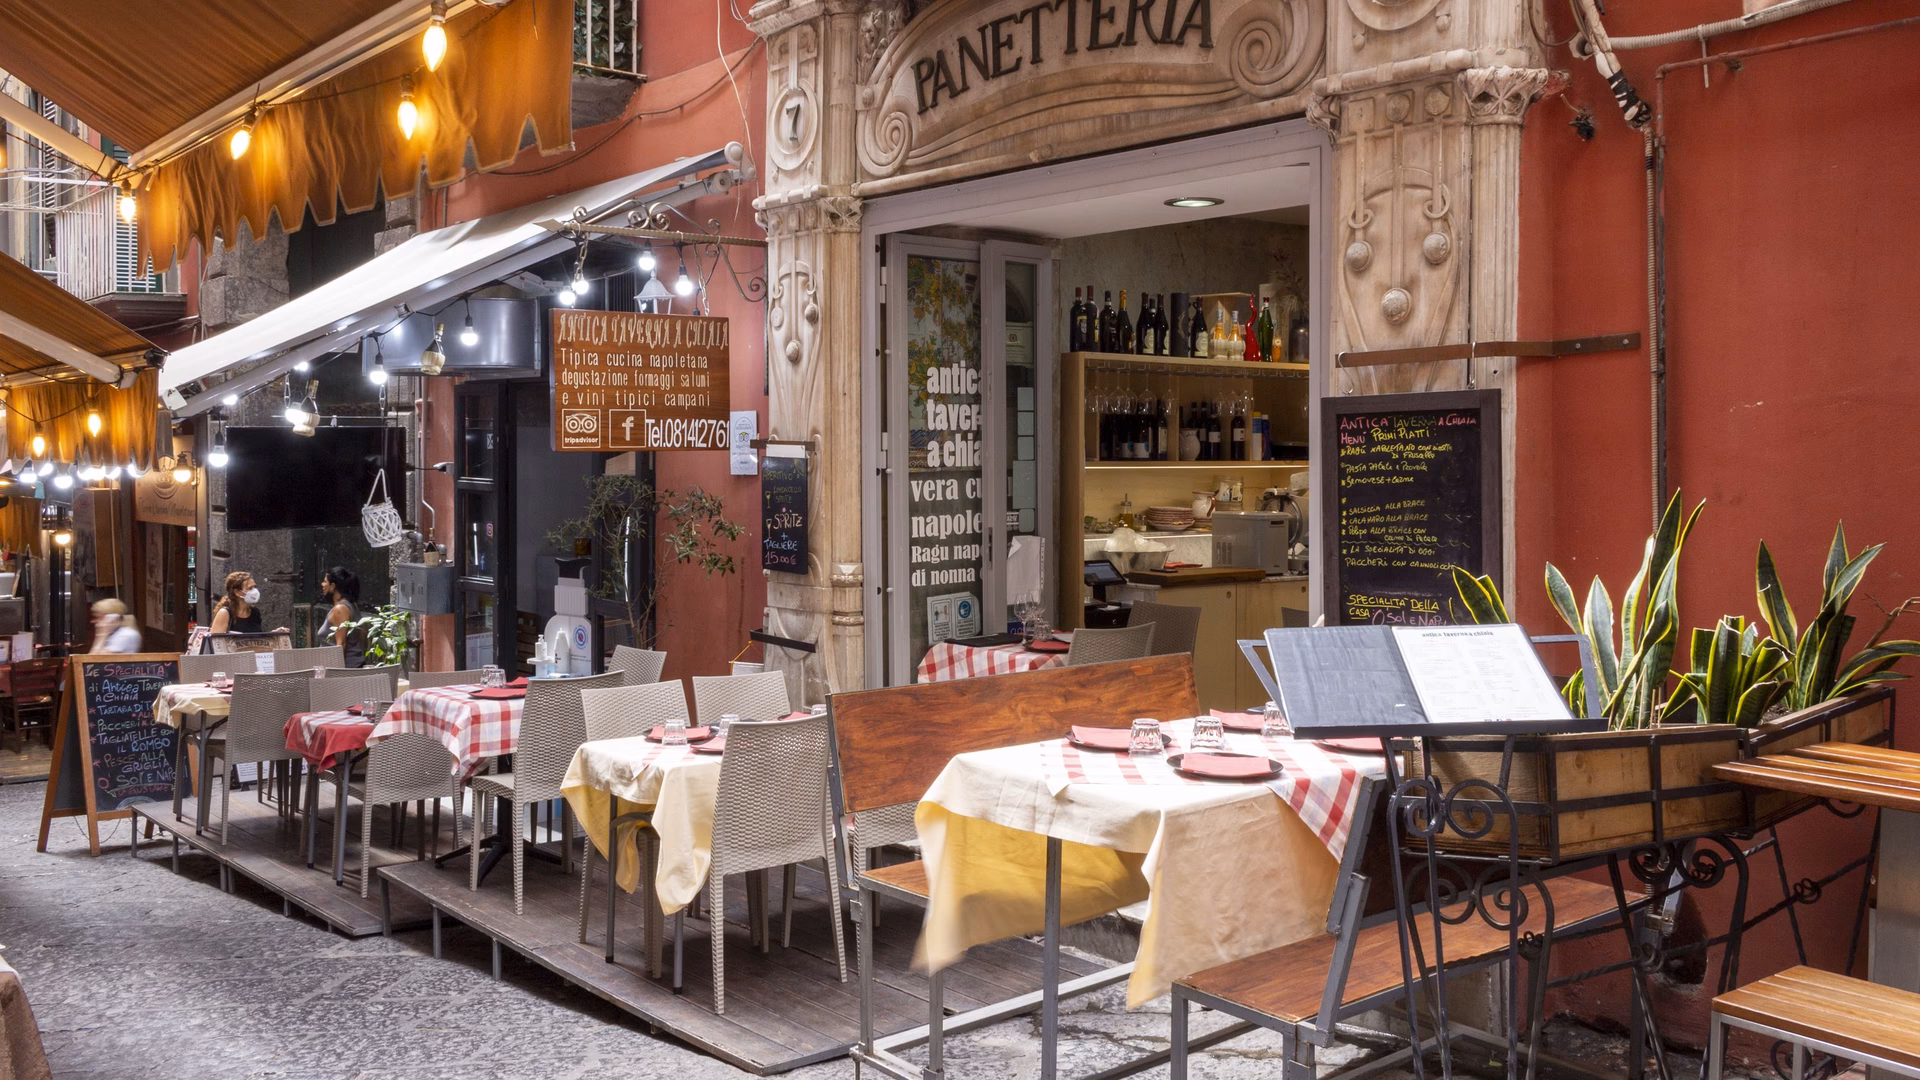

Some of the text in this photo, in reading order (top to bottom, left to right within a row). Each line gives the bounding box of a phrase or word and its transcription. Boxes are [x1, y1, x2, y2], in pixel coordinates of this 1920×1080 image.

[910, 0, 1214, 115] PANETTERIA
[786, 104, 801, 141] 7
[557, 313, 608, 346] ANTICA
[611, 314, 671, 349] TAVERNA
[673, 319, 682, 348] A
[561, 348, 708, 370] Tipica cucina napoletana
[561, 369, 710, 391] degustazione formaggi salumi
[562, 390, 710, 410] e vini tipici campani
[1340, 416, 1389, 430] ANTICA
[1388, 415, 1437, 428] TAVERNA
[1438, 417, 1444, 426] A
[564, 436, 599, 445] tripadvisor
[927, 440, 940, 467] a
[911, 478, 959, 502] vera
[773, 511, 803, 529] SPRITZ
[911, 509, 982, 539] napole
[763, 538, 798, 551] TAGLIERE
[911, 543, 983, 563] Ragu nap
[911, 567, 976, 587] di nonna
[96, 694, 102, 702] A
[131, 738, 170, 752] ROMBO
[104, 753, 135, 767] PESCE
